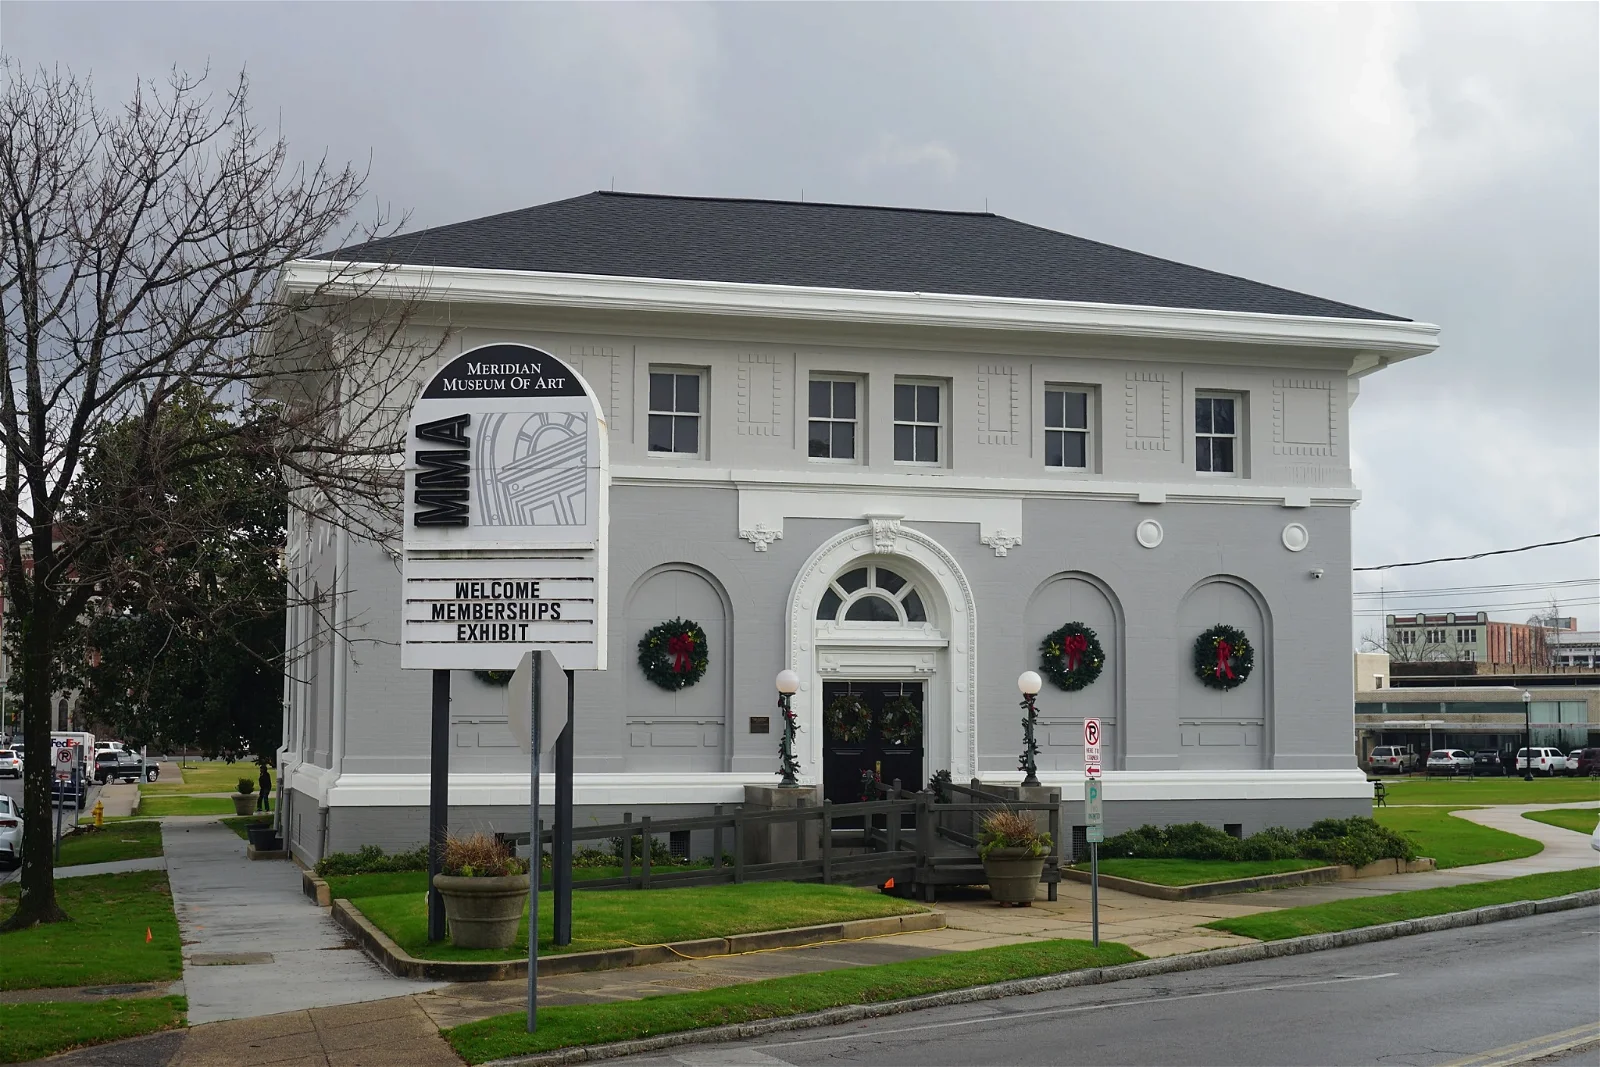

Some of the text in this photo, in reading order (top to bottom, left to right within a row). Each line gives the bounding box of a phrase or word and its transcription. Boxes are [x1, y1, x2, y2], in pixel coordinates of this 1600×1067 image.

[467, 362, 541, 375] MERIDIAN
[443, 378, 506, 391] MUSEUM
[535, 377, 566, 389] ART
[414, 413, 471, 527] MMA
[455, 581, 540, 599] WELCOME
[431, 602, 561, 620] MEMBERSHIPS
[457, 623, 529, 641] EXHIBIT
[51, 738, 80, 747] FedEx
